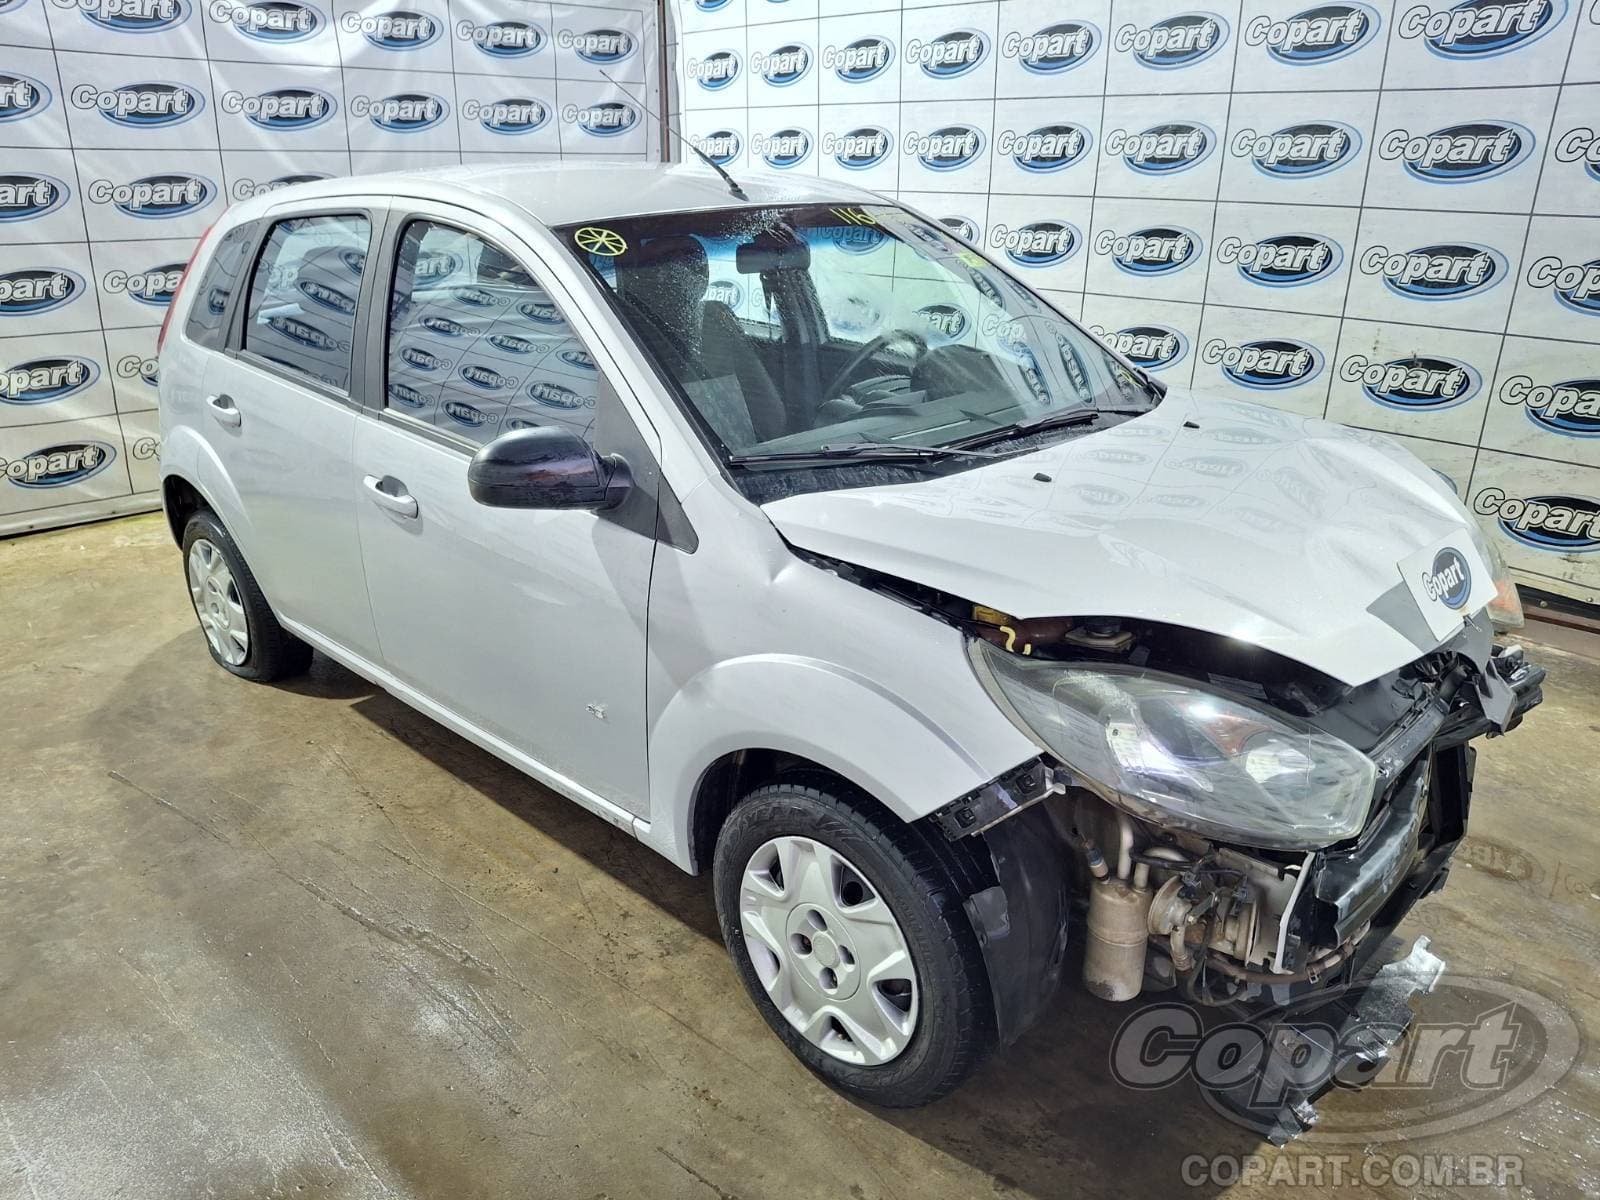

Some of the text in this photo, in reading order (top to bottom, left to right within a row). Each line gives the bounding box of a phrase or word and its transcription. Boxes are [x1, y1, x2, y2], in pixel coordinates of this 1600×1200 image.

[209, 0, 313, 32] Copart
[341, 11, 430, 40] Copart
[1245, 9, 1364, 53] Copart
[1399, 0, 1546, 47] Copart
[456, 20, 538, 48] Copart
[557, 29, 630, 56] Copart
[1002, 26, 1092, 64] Copart
[1115, 18, 1217, 60] Copart
[687, 53, 736, 82] Copart
[750, 49, 806, 77] Copart
[822, 43, 888, 75] Copart
[905, 35, 981, 70] Copart
[71, 84, 190, 118] Copart
[221, 91, 325, 119] Copart
[351, 95, 438, 122] Copart
[462, 100, 543, 127] Copart
[562, 104, 632, 128] Copart
[752, 132, 808, 162] Copart
[822, 131, 888, 162] Copart
[904, 131, 979, 162] Copart
[997, 129, 1083, 161] Copart
[1104, 128, 1205, 164] Copart
[1231, 128, 1346, 166] Copart
[1379, 128, 1517, 169] Copart
[89, 180, 201, 210] Copart
[990, 223, 1073, 256] Copart
[1095, 230, 1192, 264] Copart
[1217, 237, 1329, 272] Copart
[1360, 245, 1489, 285] Copart
[103, 270, 185, 298] Copa
[1202, 338, 1310, 376] Copart
[1340, 355, 1465, 398] Copart
[1499, 375, 1600, 418] Copa
[1422, 556, 1465, 602] Copart
